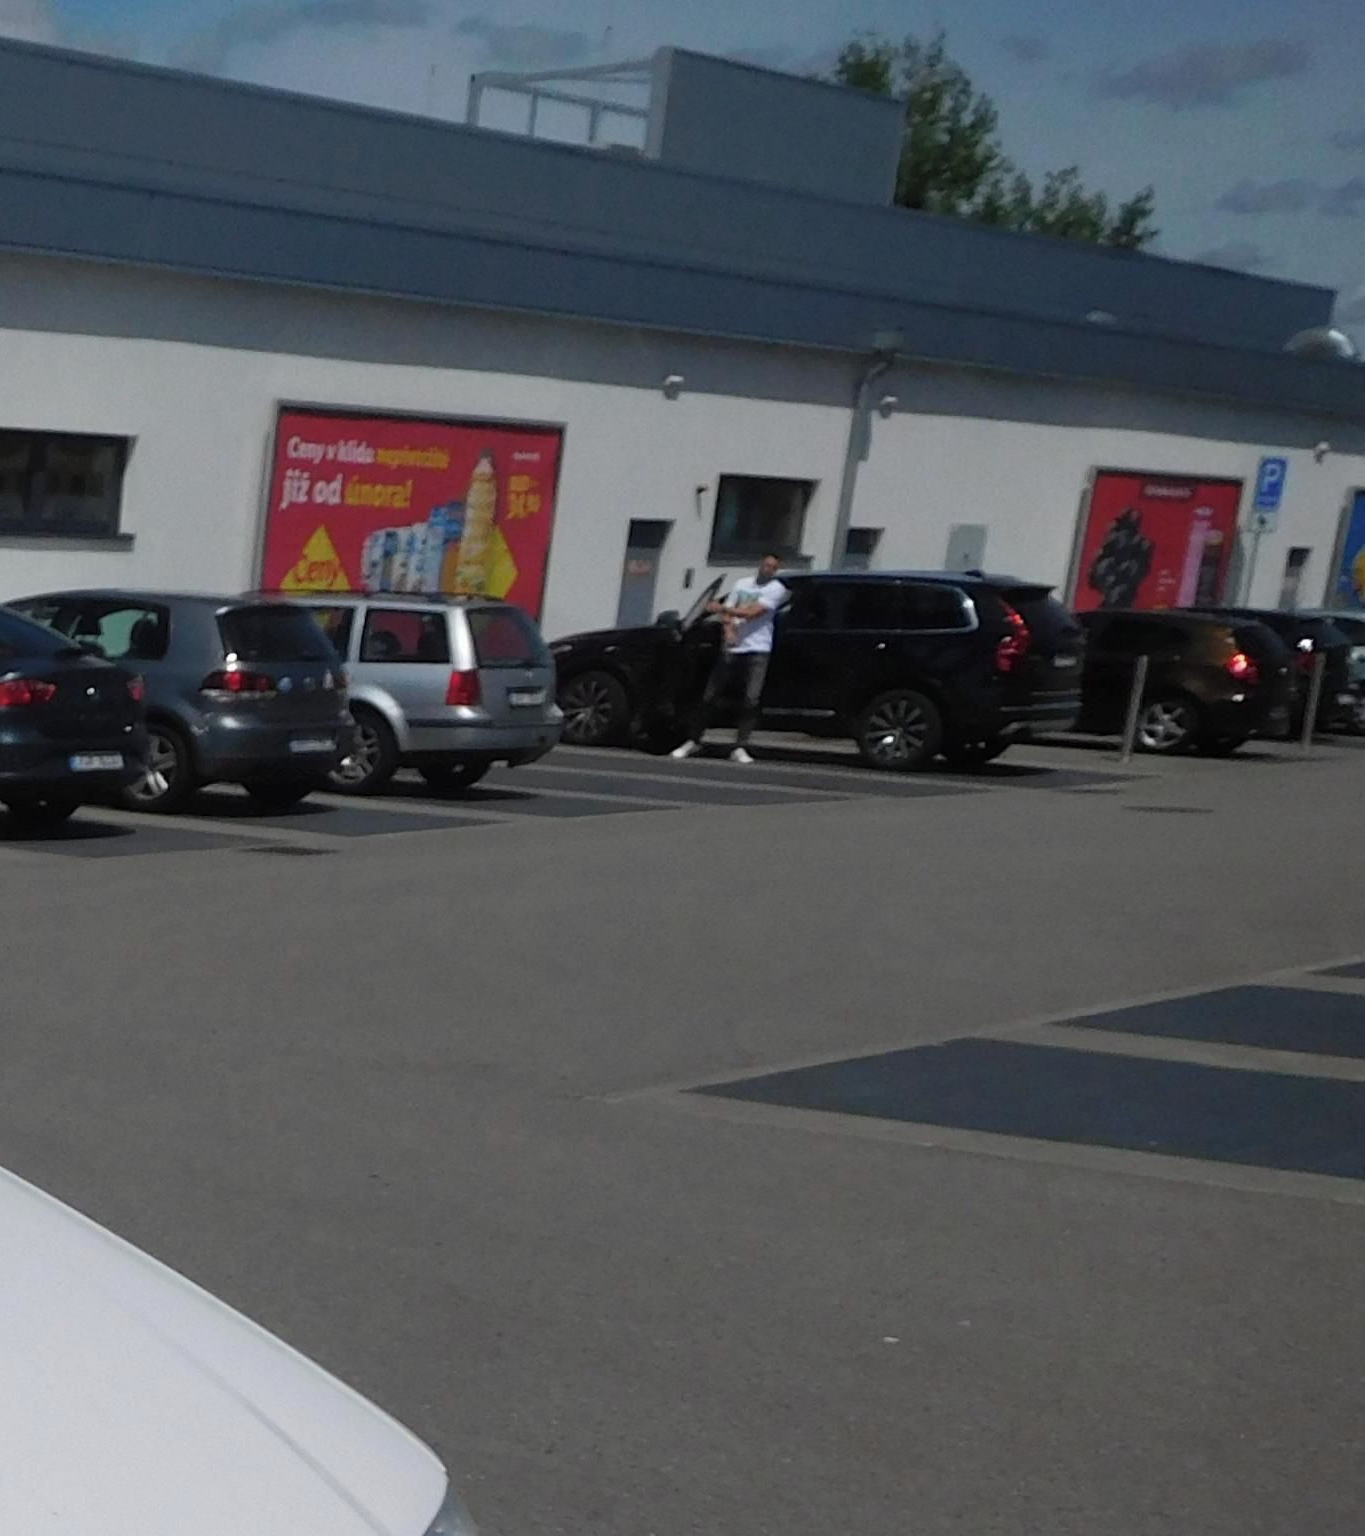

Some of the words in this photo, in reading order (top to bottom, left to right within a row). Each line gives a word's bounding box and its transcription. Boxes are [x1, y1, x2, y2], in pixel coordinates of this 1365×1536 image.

[278, 468, 311, 511] již
[312, 473, 344, 505] od
[1263, 463, 1281, 492] P
